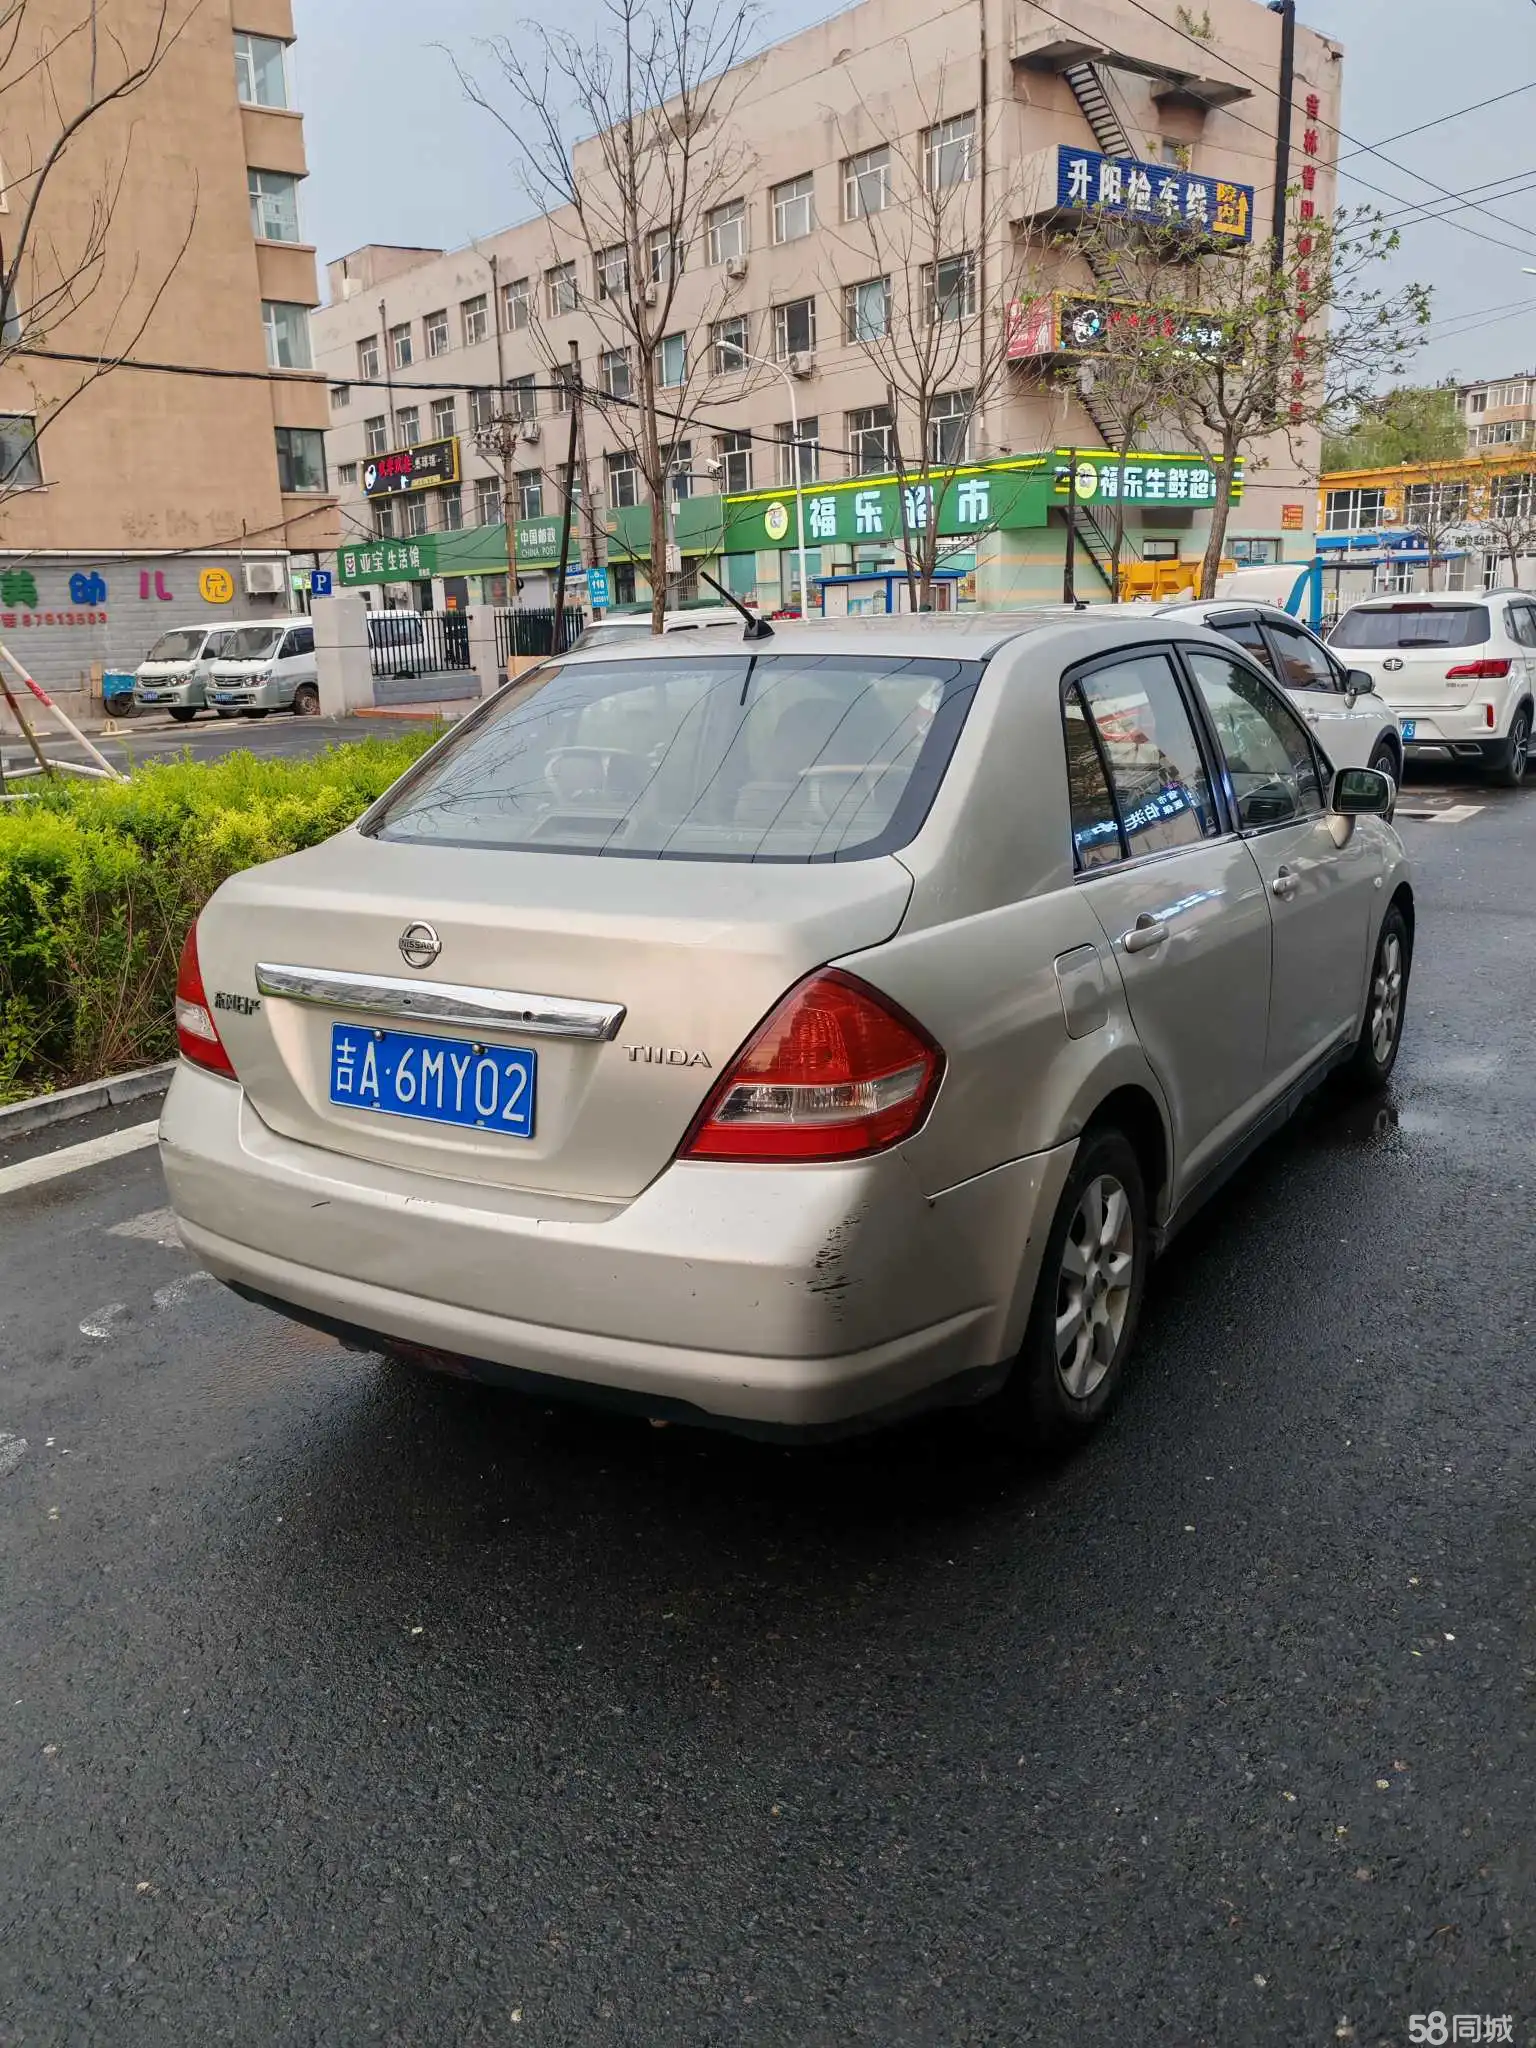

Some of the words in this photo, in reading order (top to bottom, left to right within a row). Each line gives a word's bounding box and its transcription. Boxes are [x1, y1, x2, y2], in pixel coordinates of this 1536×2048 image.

[809, 479, 991, 538] 福乐超市
[520, 527, 556, 546] 中国邮政
[520, 547, 540, 558] CHINA
[543, 545, 556, 557] POST
[316, 574, 327, 591] P
[400, 938, 435, 951] NISSAN
[621, 1044, 712, 1068] TIIDA
